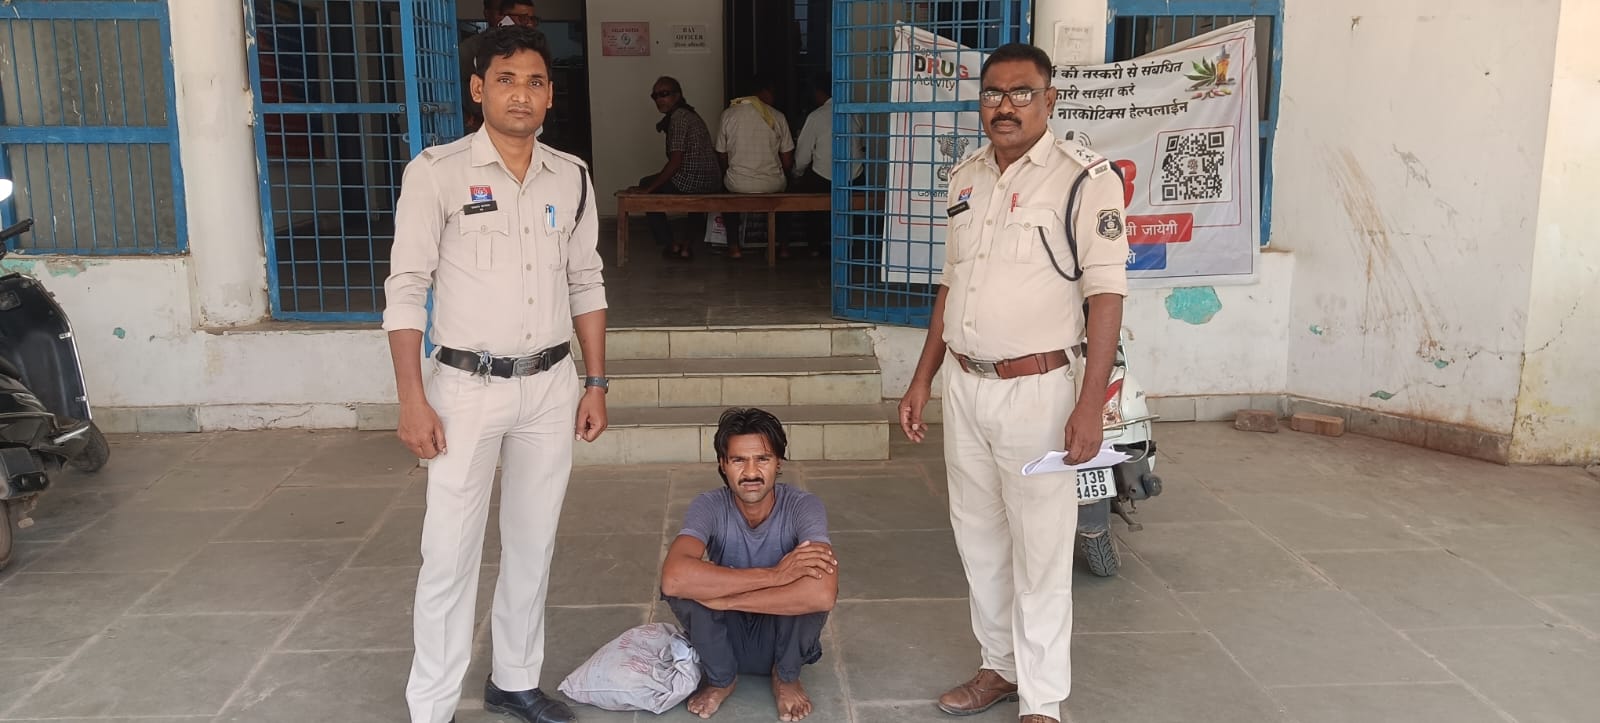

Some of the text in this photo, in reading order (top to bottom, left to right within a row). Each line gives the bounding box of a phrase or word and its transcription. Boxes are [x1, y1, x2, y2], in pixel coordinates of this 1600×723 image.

[914, 54, 969, 78] DRUG
[1061, 64, 1078, 79] की
[1082, 63, 1123, 79] तस्करी
[1127, 63, 1137, 78] से
[914, 74, 955, 91] Actvity
[1082, 87, 1113, 101] साझा
[1058, 104, 1127, 121] नारकोटिक्स
[1129, 99, 1189, 120] हेल्पलाईन
[1141, 219, 1178, 236] जायेगी
